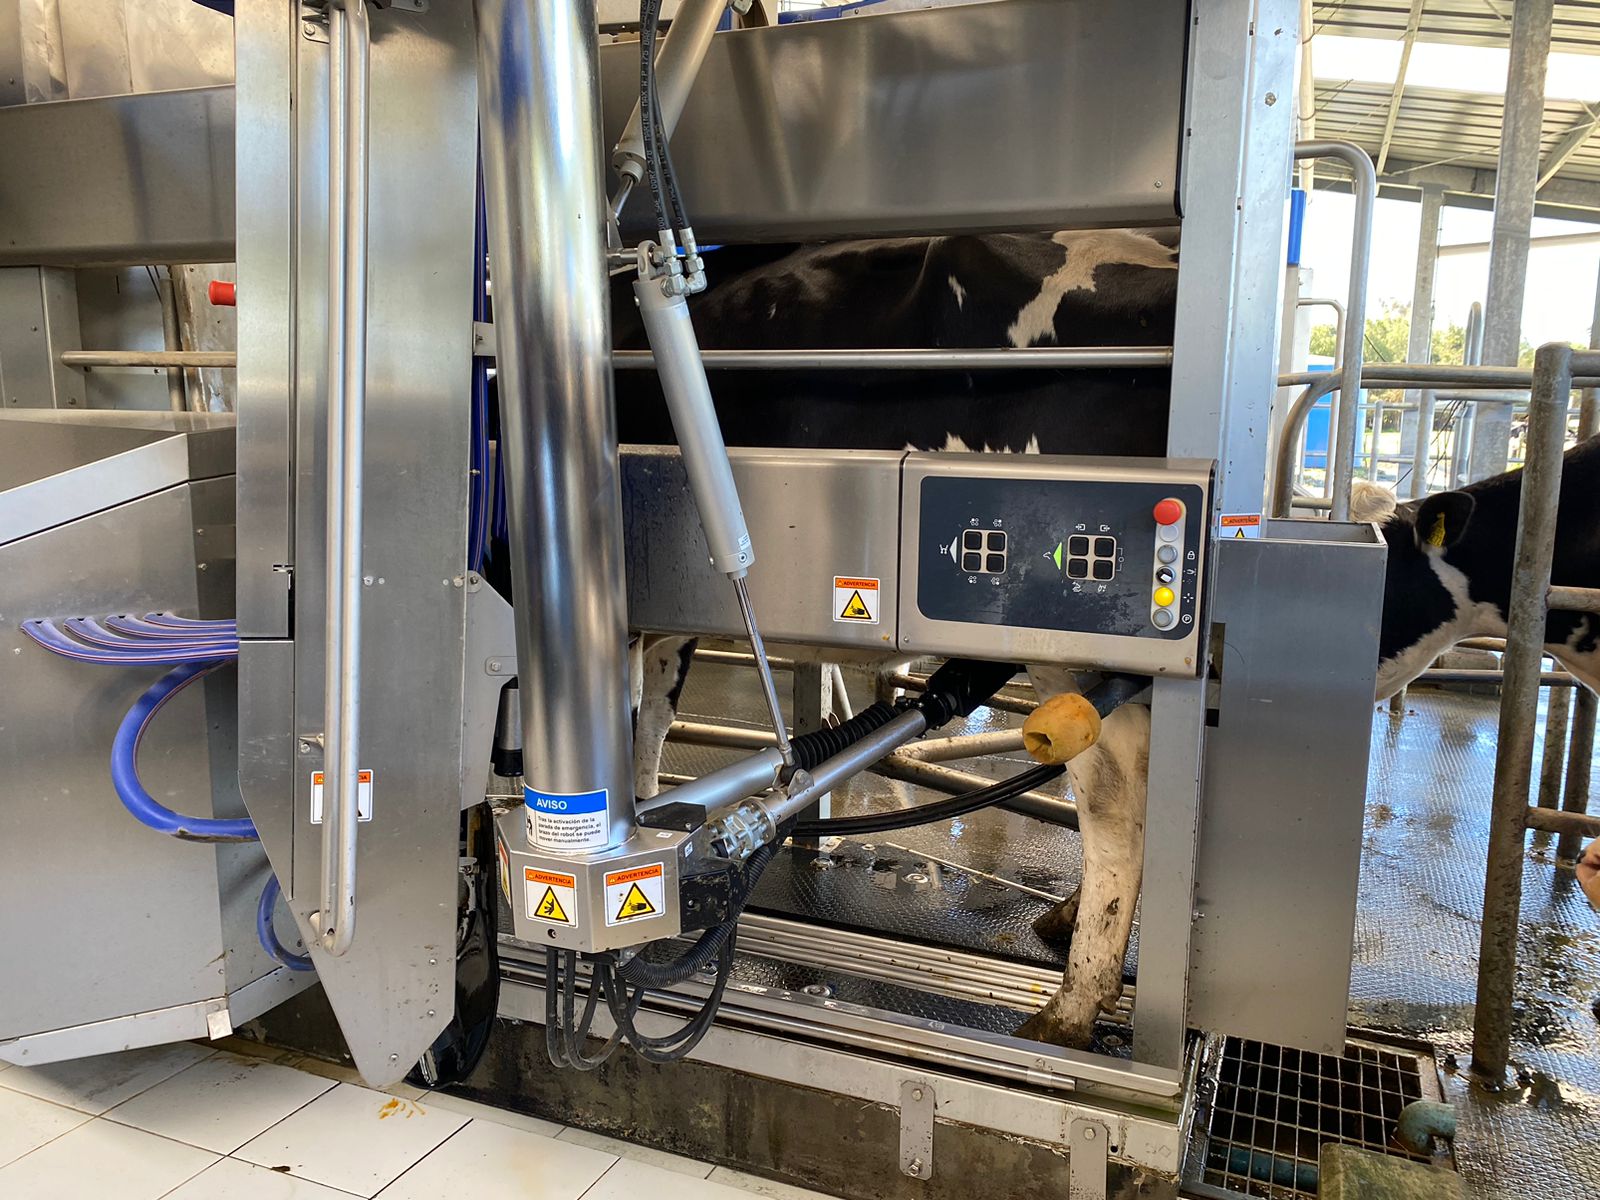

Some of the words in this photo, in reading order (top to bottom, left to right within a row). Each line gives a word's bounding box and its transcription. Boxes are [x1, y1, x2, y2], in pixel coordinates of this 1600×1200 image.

[640, 90, 648, 107] MAX
[536, 798, 568, 810] AVISO
[534, 874, 572, 884] ADVERTENCIA
[617, 868, 658, 880] ADVERTENCIA
